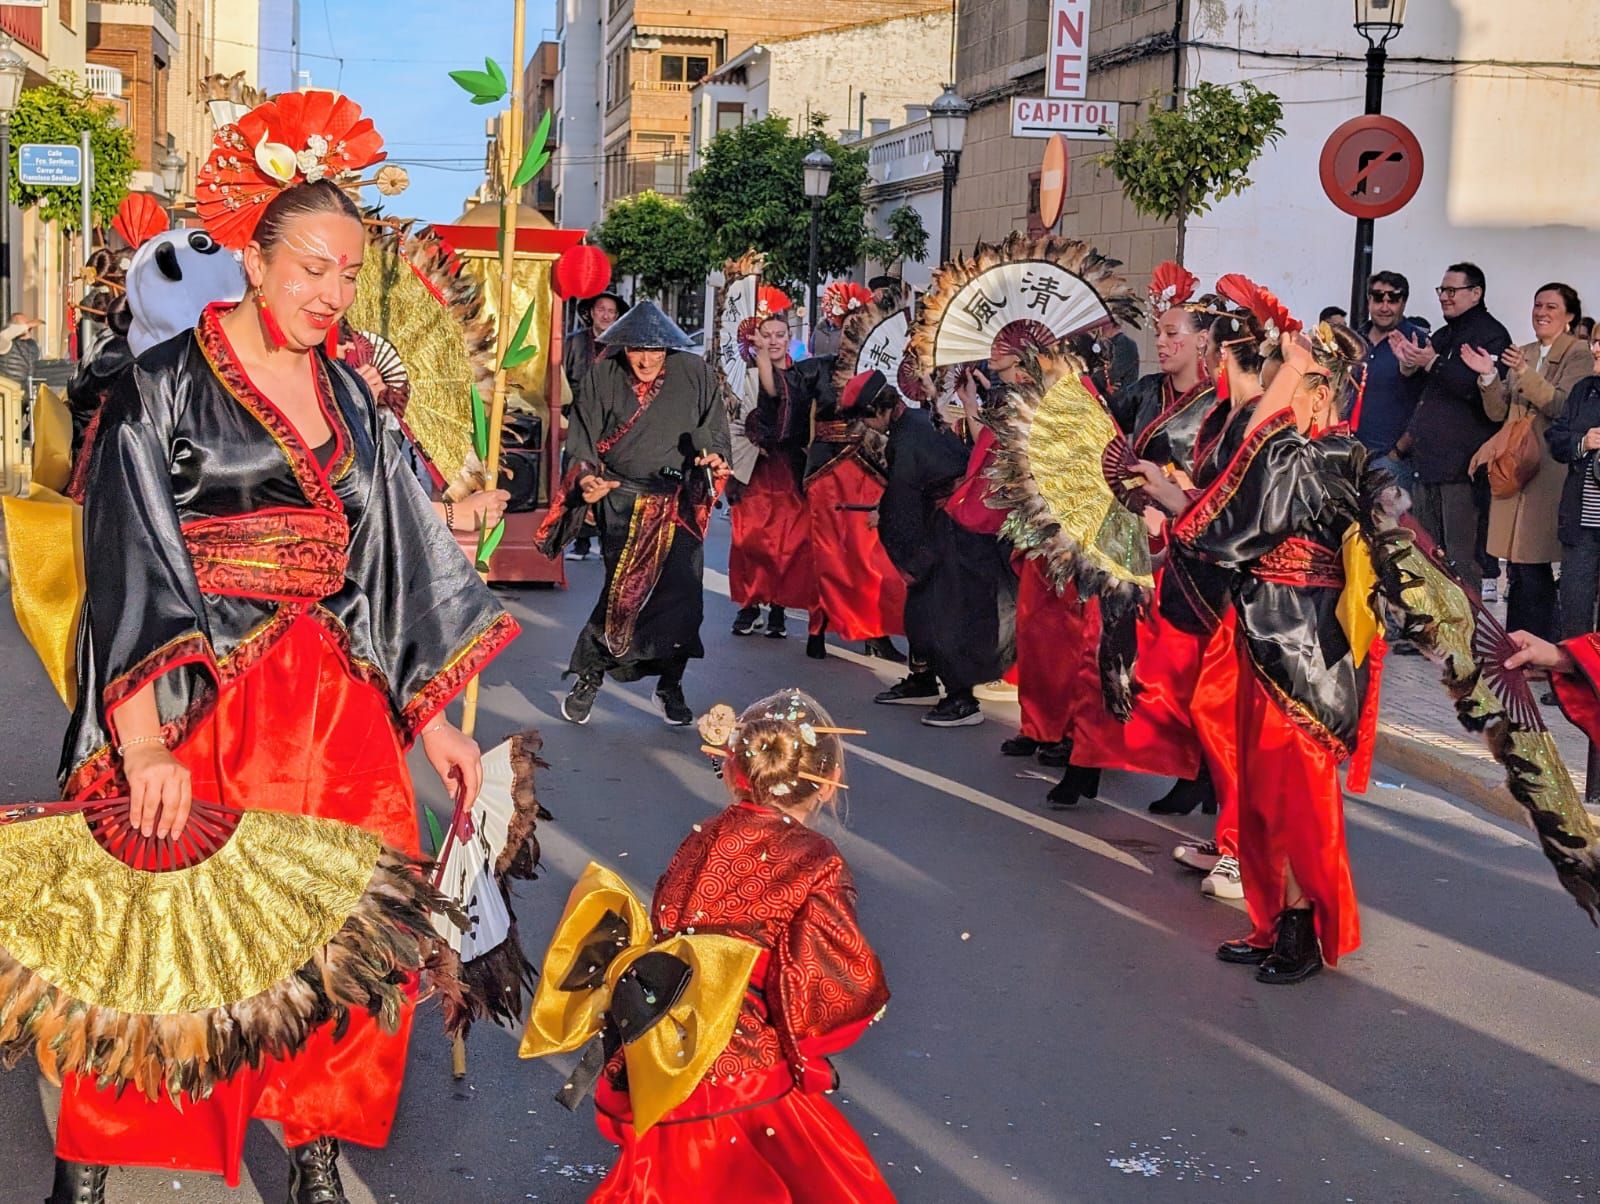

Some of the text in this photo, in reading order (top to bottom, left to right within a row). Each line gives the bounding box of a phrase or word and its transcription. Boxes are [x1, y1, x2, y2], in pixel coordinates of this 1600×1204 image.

[1055, 0, 1085, 92] NE
[1017, 102, 1114, 125] CAPITOL
[36, 166, 55, 174] Carrer
